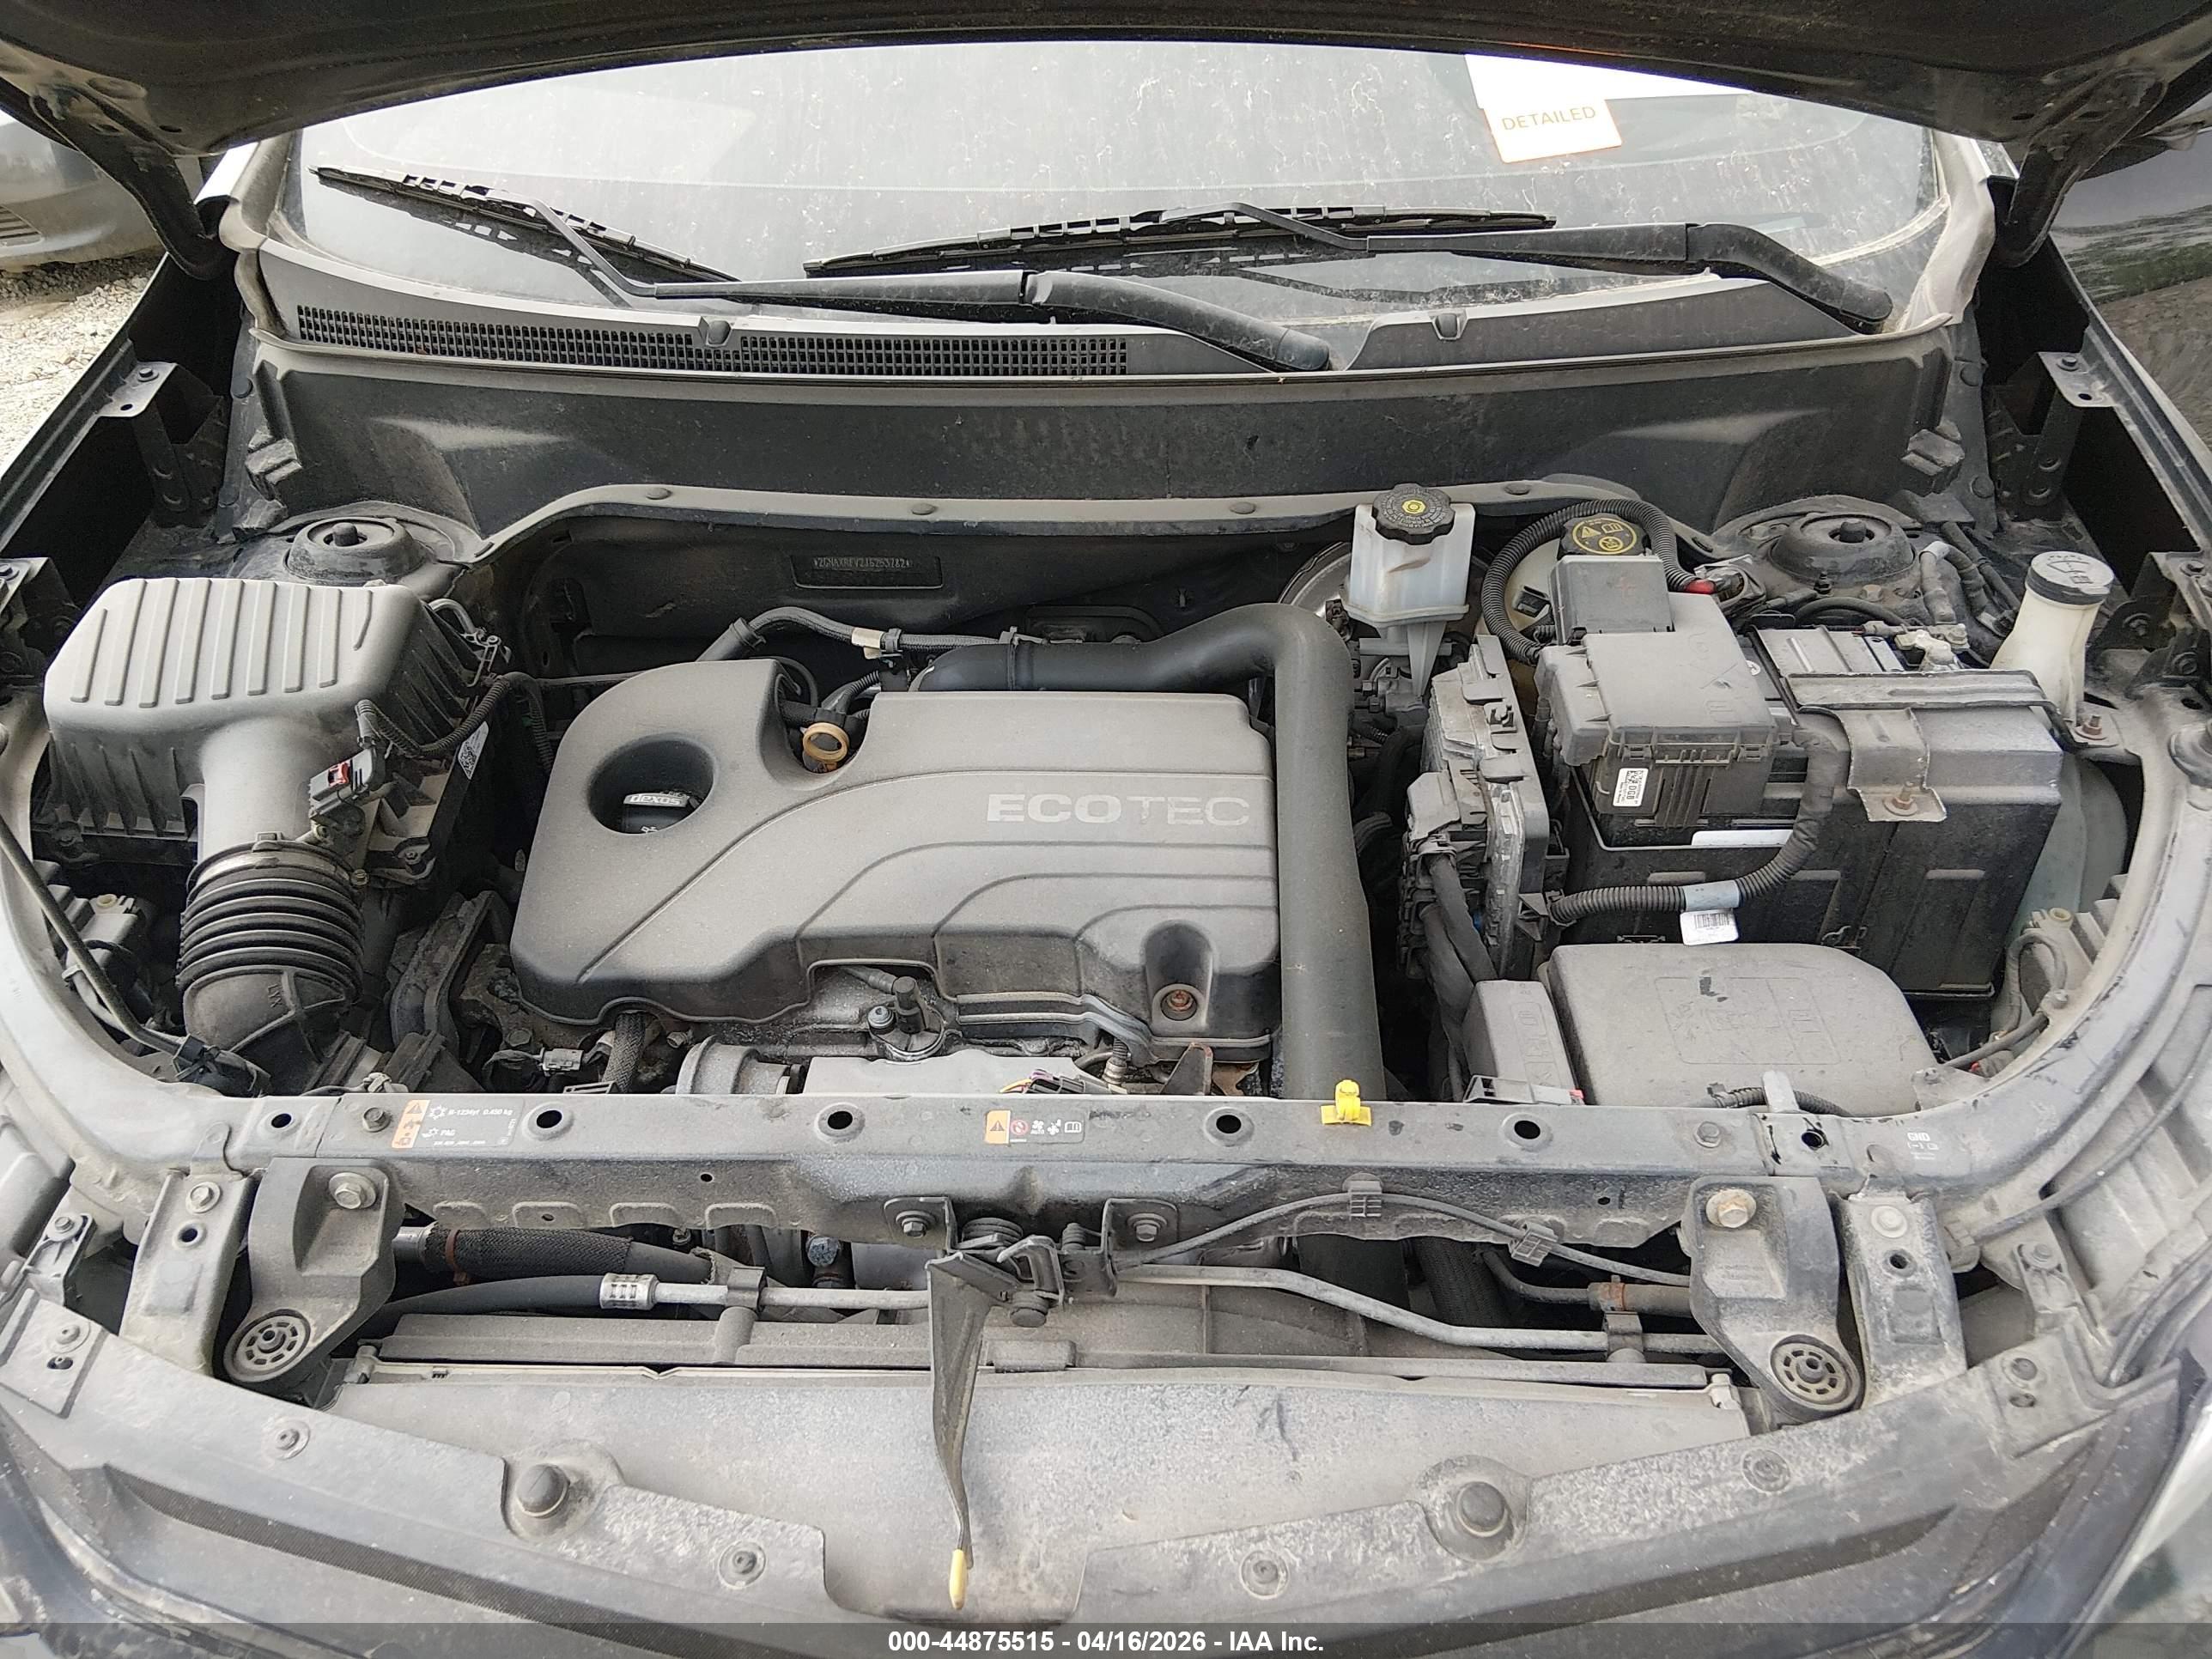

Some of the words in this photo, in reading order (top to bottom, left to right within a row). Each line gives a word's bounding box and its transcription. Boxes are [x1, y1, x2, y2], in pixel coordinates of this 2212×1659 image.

[1501, 106, 1596, 131] DETAILED
[629, 794, 681, 805] dexos
[988, 793, 1249, 825] ECOTEC
